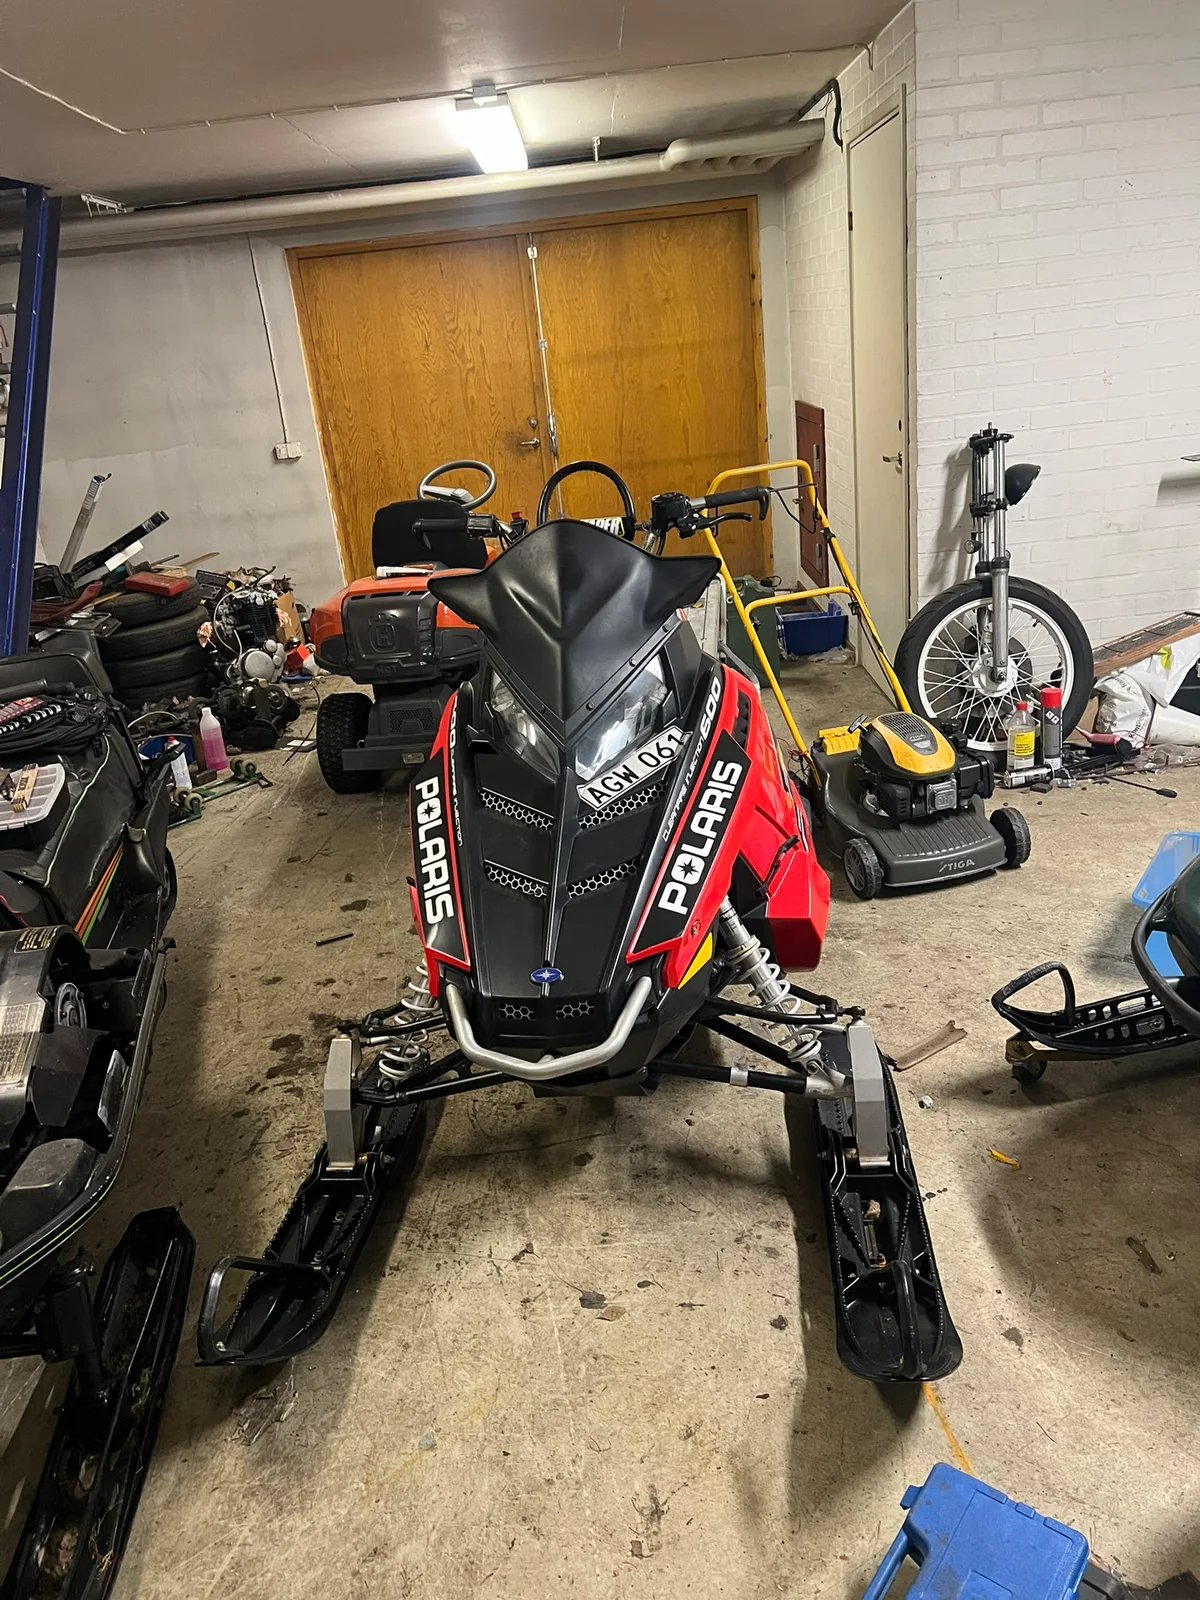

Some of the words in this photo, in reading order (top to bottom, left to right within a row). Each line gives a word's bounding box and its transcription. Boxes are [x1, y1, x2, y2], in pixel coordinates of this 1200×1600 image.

[700, 676, 721, 741] 600
[587, 764, 639, 804] AGW
[638, 734, 684, 768] 061
[416, 776, 454, 925] POLARIS
[658, 760, 743, 915] POLARIS
